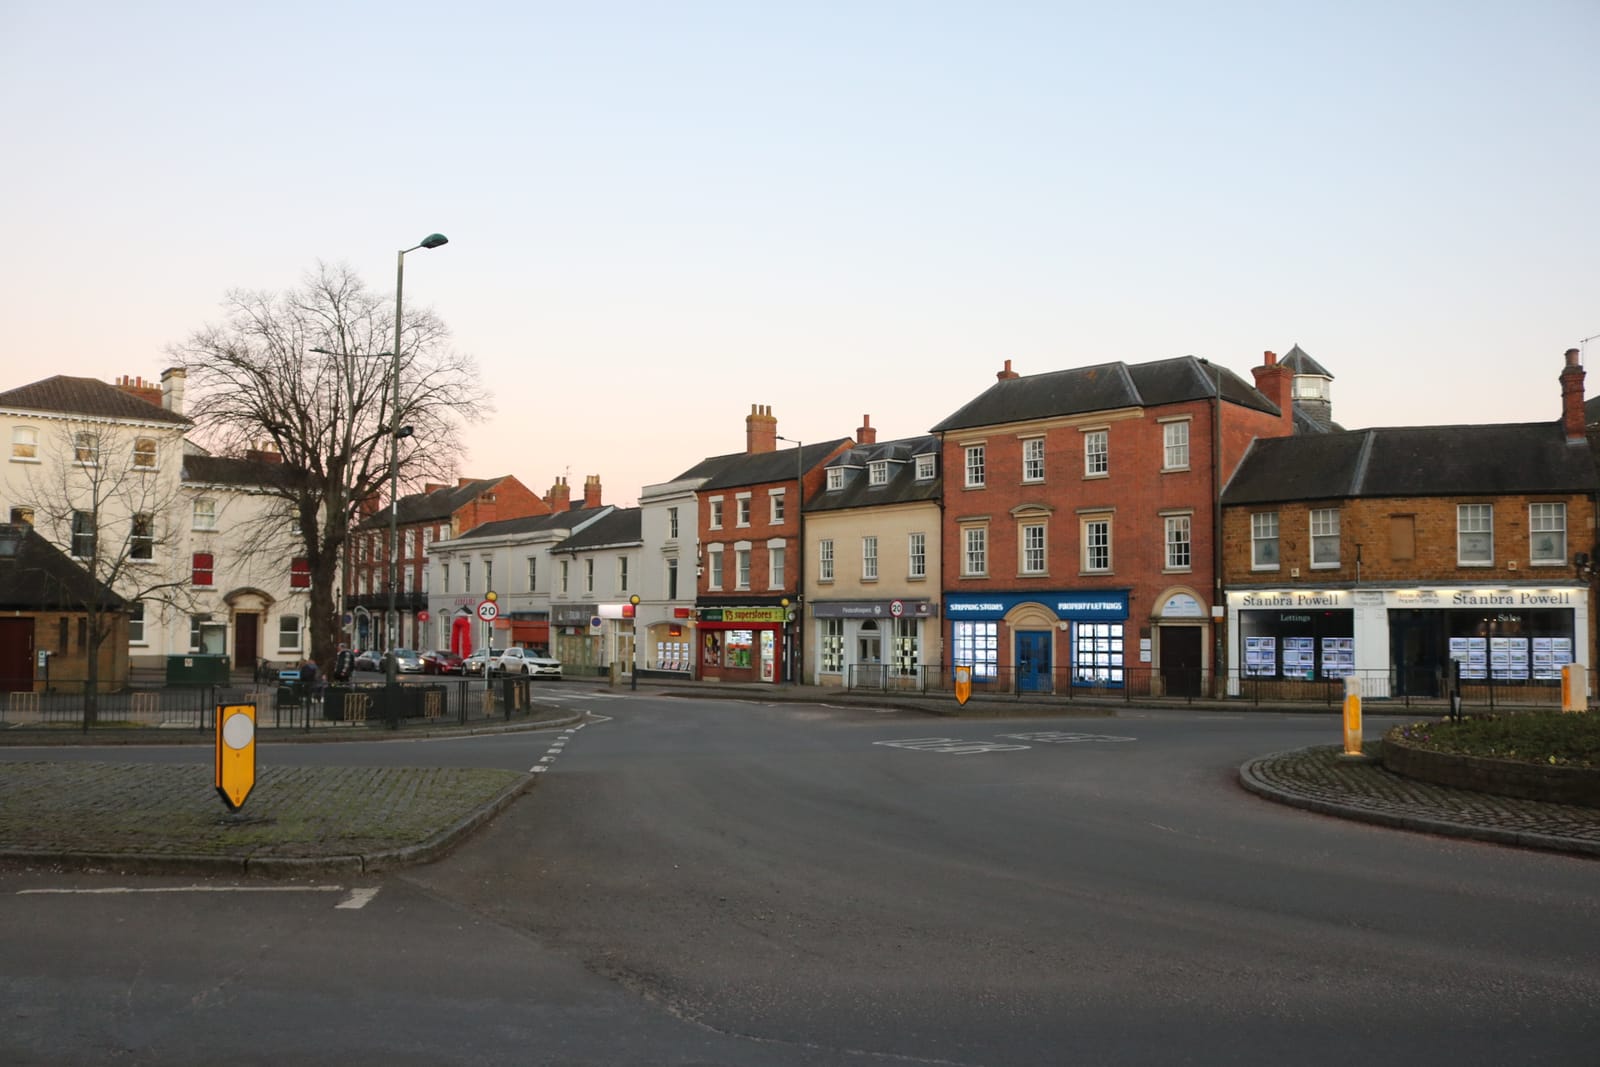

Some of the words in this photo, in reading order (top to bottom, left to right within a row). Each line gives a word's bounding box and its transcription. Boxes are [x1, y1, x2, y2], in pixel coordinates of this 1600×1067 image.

[1243, 595, 1293, 606] Stanbra
[1298, 594, 1339, 606] Powell
[1453, 592, 1514, 605] Stanbra
[1521, 592, 1570, 605] Powell
[481, 606, 496, 616] 20
[734, 610, 772, 619] superstores
[1280, 613, 1311, 622] Lettings
[1498, 614, 1521, 622] Sales
